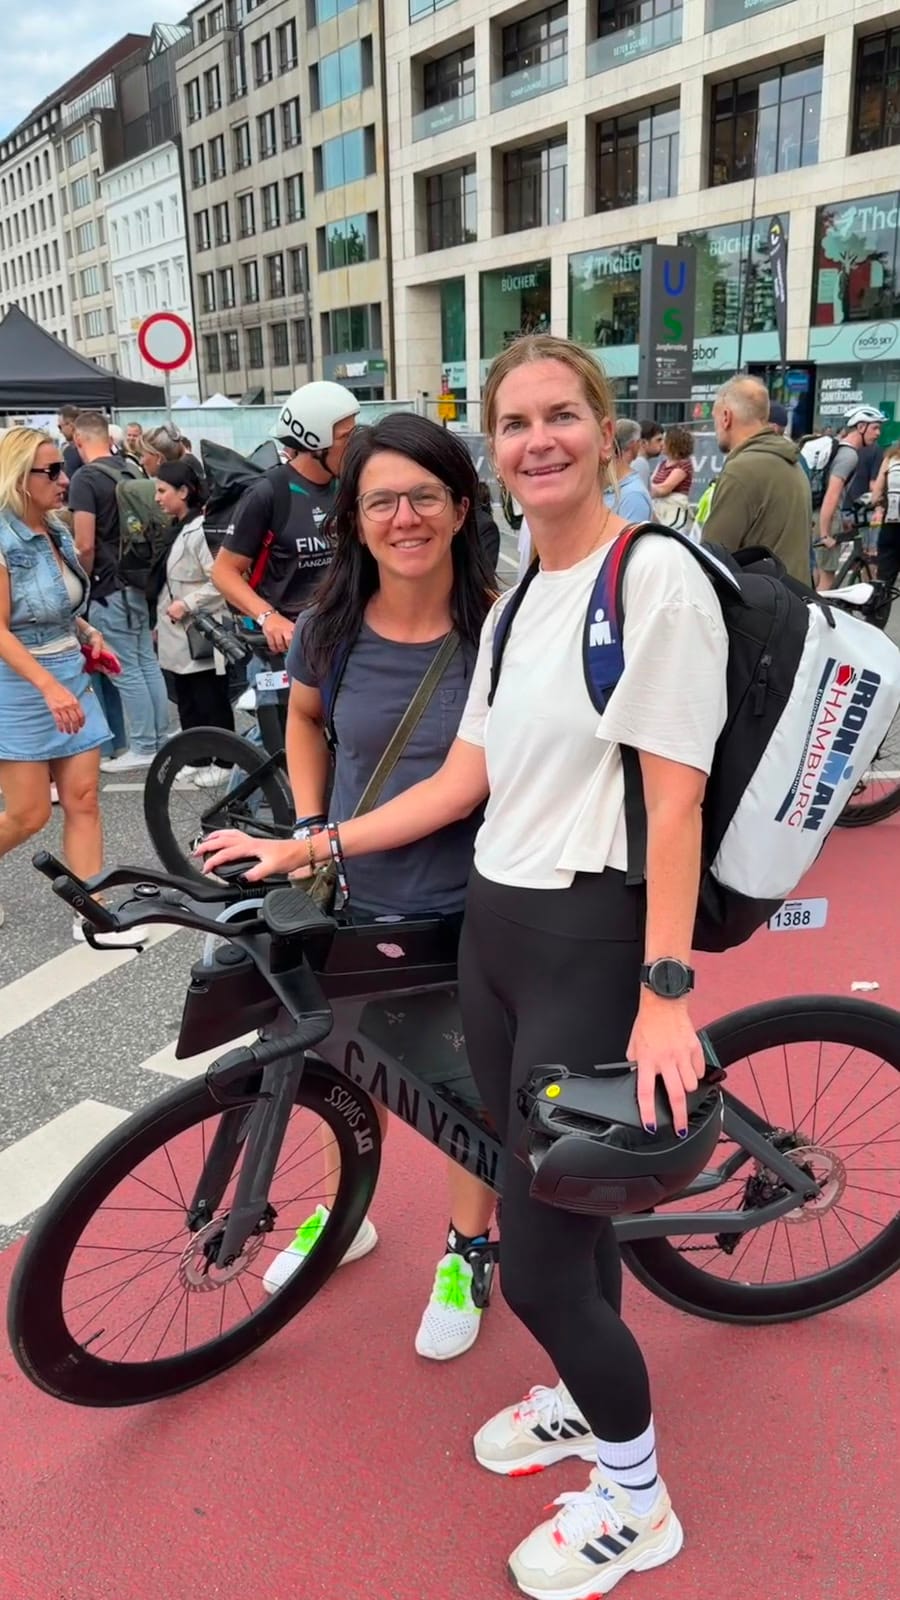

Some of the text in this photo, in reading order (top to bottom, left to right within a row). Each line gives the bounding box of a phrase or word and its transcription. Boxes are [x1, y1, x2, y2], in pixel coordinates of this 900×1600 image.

[709, 233, 761, 257] BÜCHER
[501, 273, 536, 292] BÜCHER
[663, 260, 687, 296] U
[663, 307, 684, 342] S
[692, 344, 719, 360] abor
[297, 557, 334, 569] LANZAR
[787, 687, 848, 828] HAMBURG
[802, 668, 882, 832] IRONMAN
[774, 910, 811, 928] 1388
[324, 1085, 374, 1156] DT SWISS
[344, 1040, 498, 1187] CANYON
